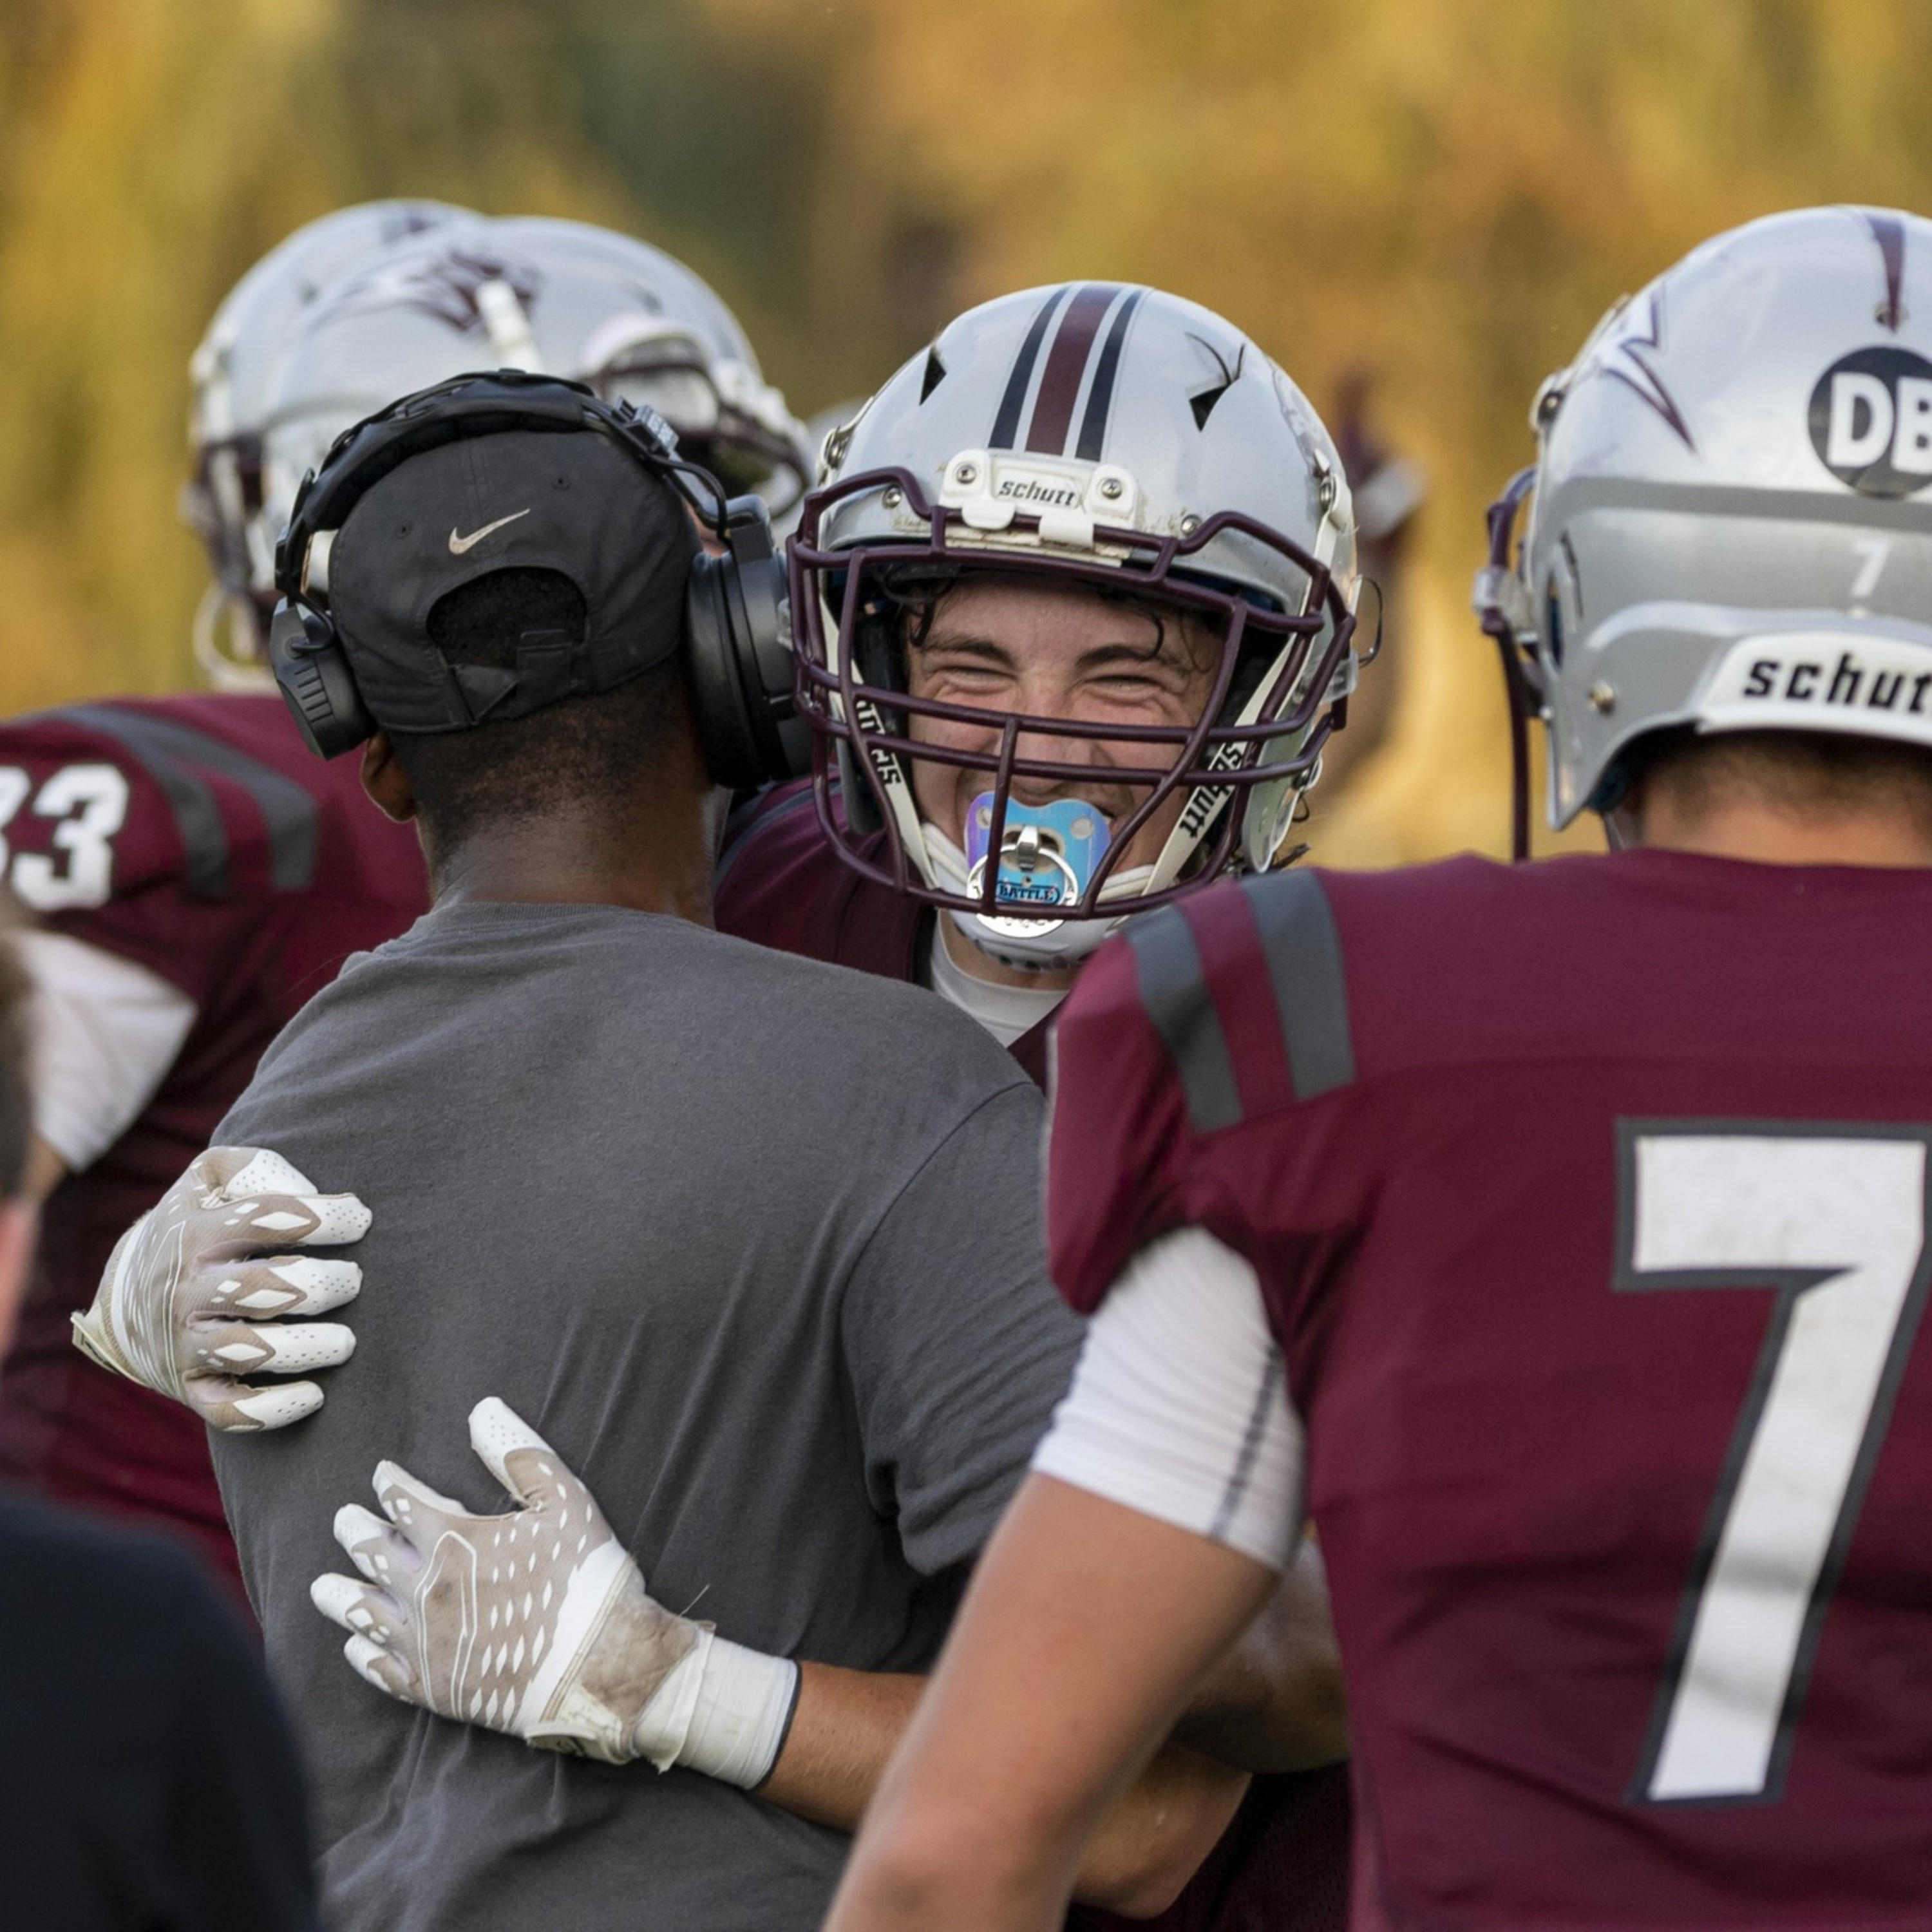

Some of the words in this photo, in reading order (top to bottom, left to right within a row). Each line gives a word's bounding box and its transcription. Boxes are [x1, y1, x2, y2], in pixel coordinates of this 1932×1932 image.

[1827, 371, 1932, 475] DB
[999, 480, 1075, 506] schutt
[1850, 539, 1891, 599] 7
[0, 764, 129, 910] 3
[999, 884, 1054, 901] BATTLE
[1628, 1131, 1929, 1801] 7
